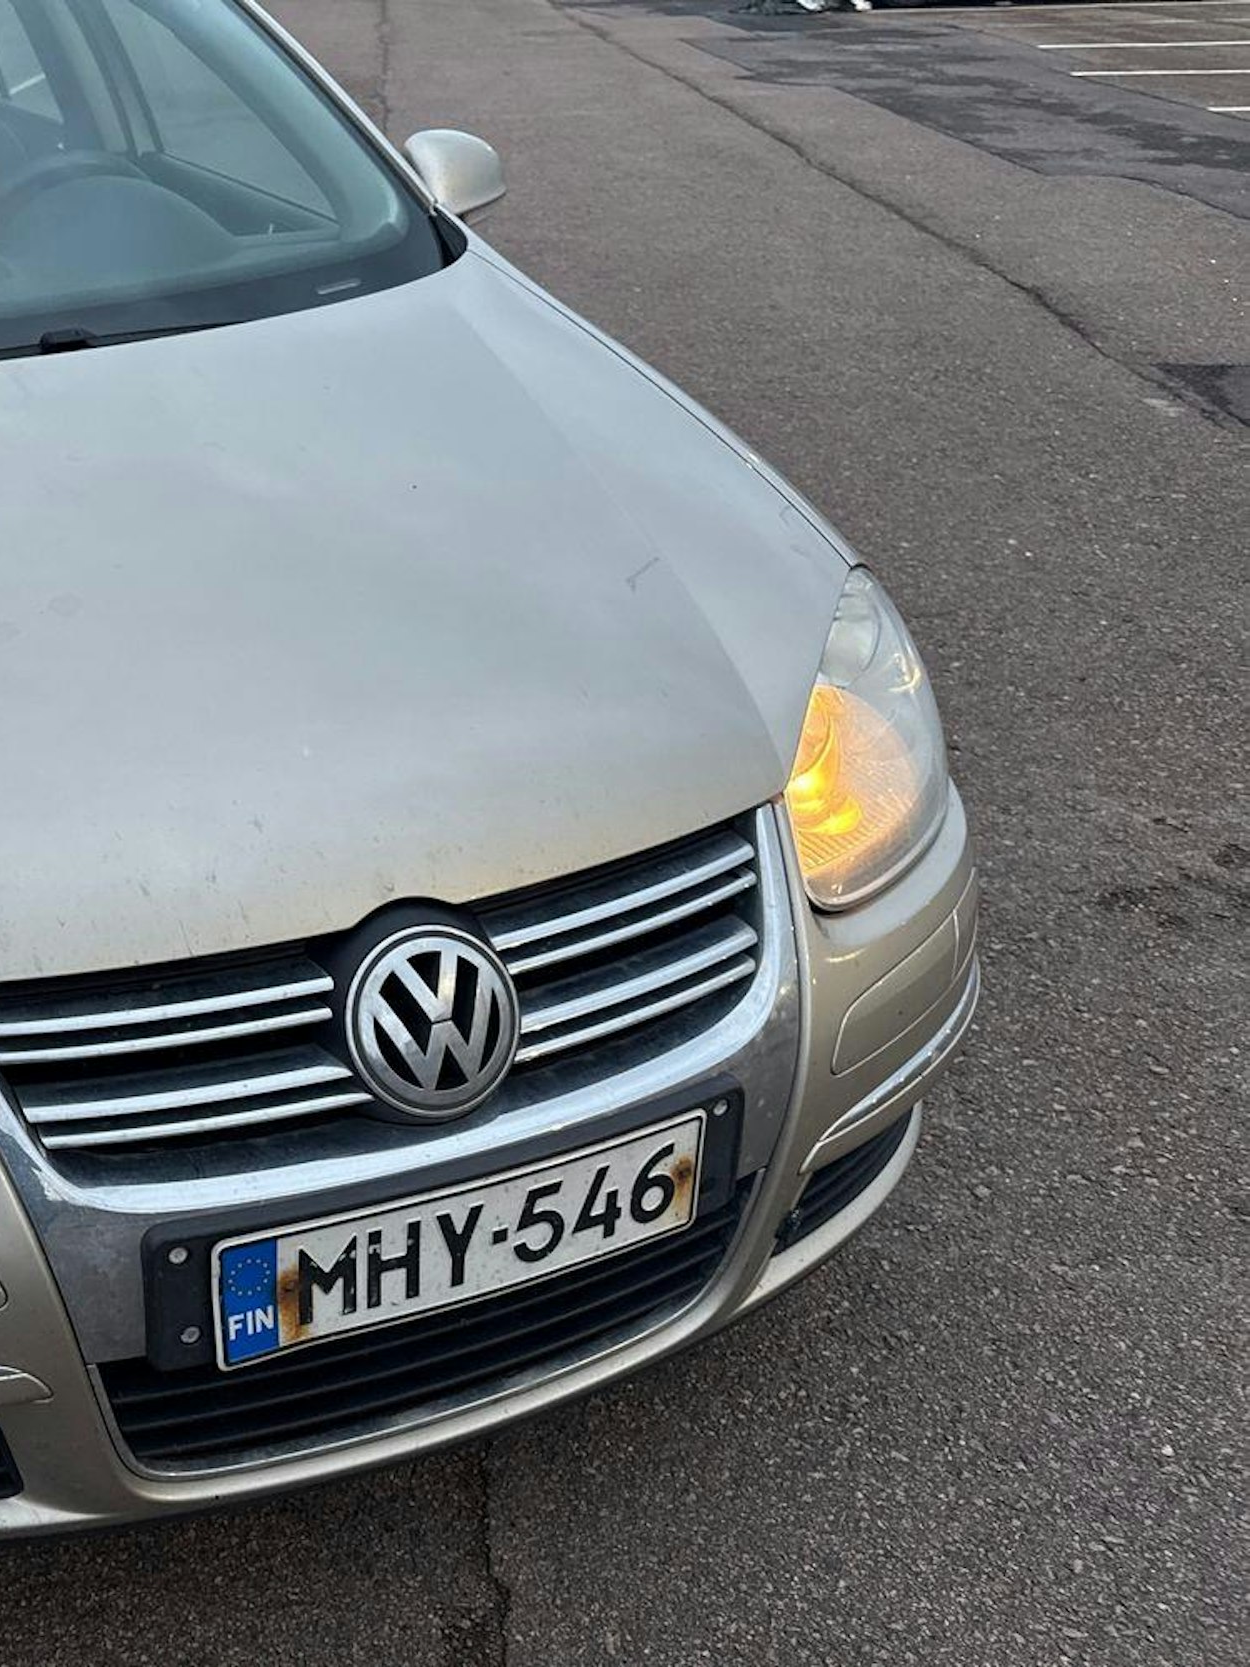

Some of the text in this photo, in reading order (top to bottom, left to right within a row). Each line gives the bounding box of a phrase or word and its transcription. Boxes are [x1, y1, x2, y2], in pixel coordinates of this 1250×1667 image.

[358, 937, 511, 1104] VW
[298, 1143, 676, 1326] MHY-546
[228, 1304, 276, 1341] FIN
